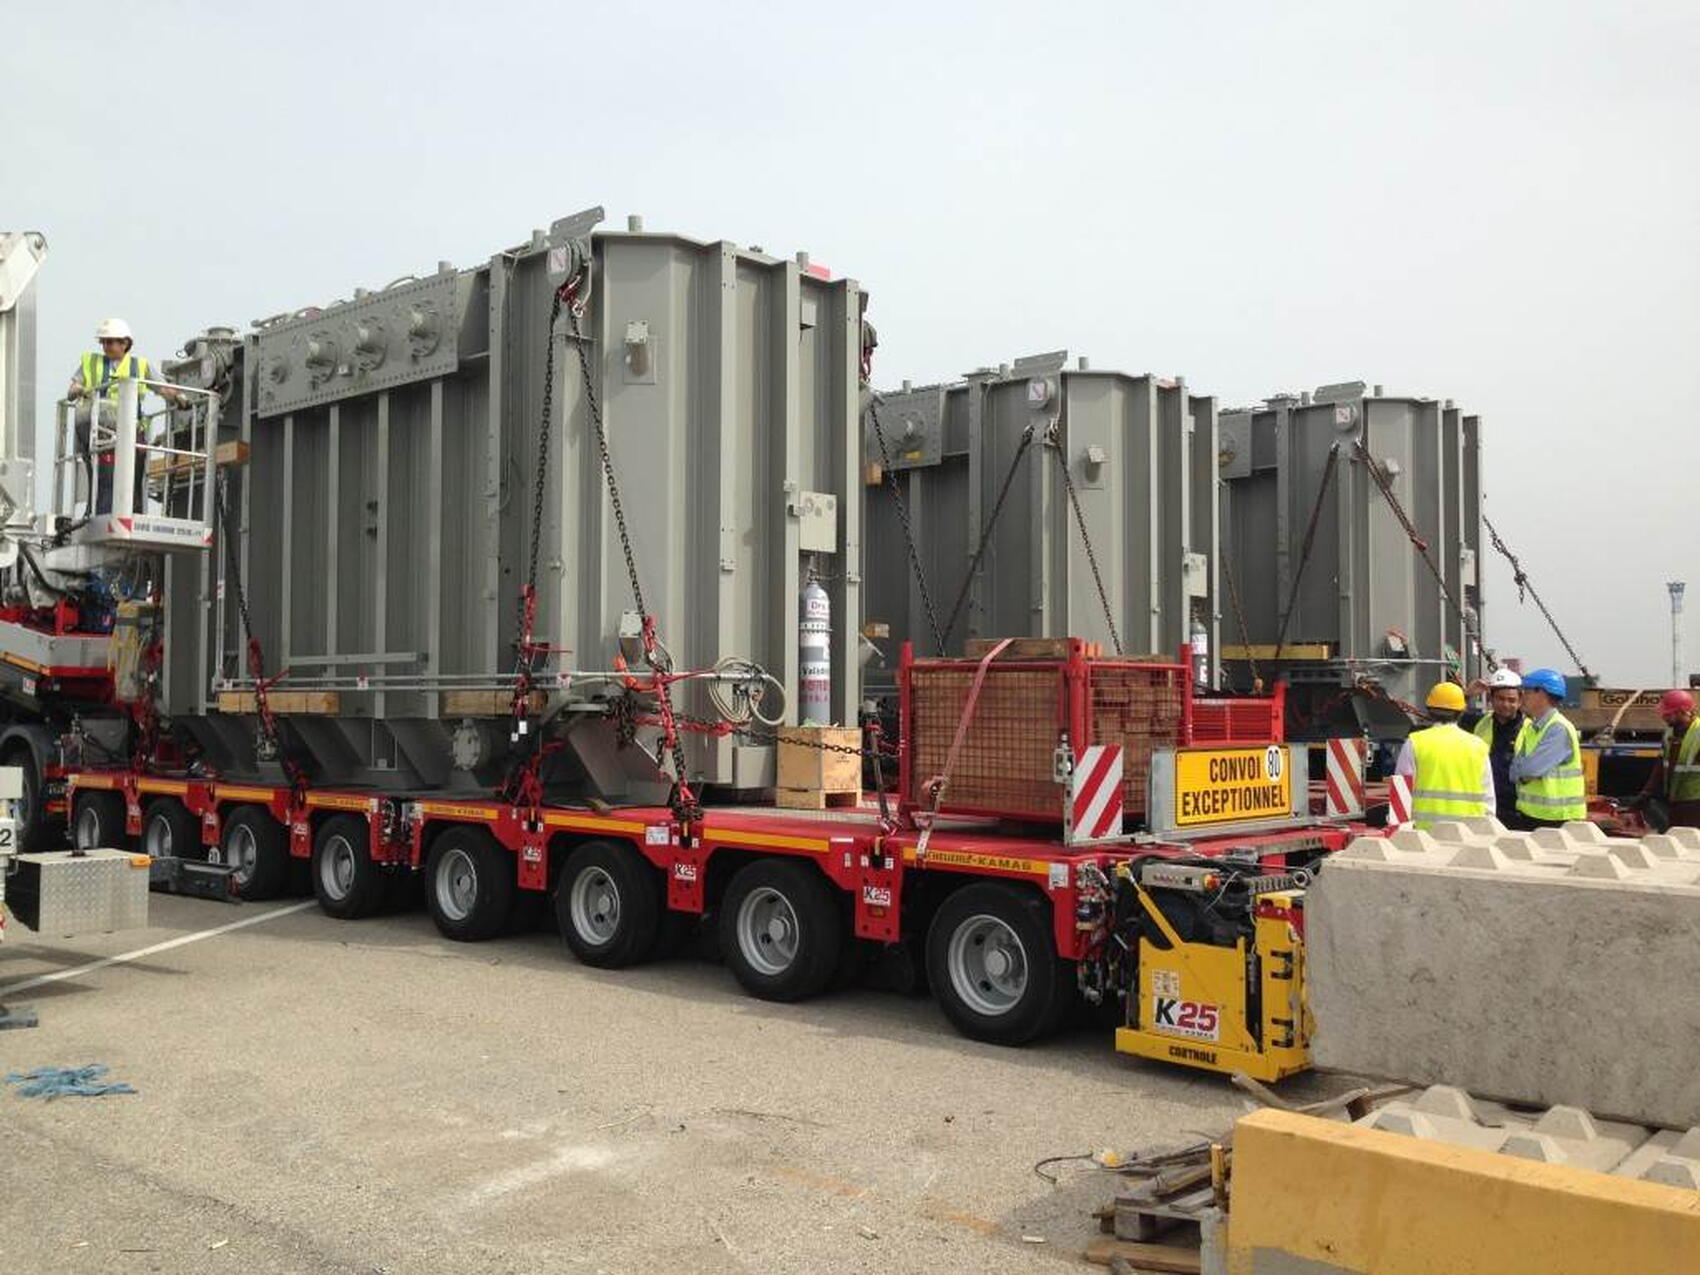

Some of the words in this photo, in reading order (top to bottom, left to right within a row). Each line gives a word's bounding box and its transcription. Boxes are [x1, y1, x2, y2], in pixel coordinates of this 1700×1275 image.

[1604, 690, 1663, 705] Goldho
[1209, 756, 1261, 783] CONVOI
[1266, 749, 1280, 778] 80
[1182, 785, 1286, 817] EXCEPTIONNEL
[0, 828, 12, 847] 2
[864, 887, 890, 902] K25
[1155, 998, 1217, 1032] K25
[1169, 1046, 1217, 1064] CONTROLE
